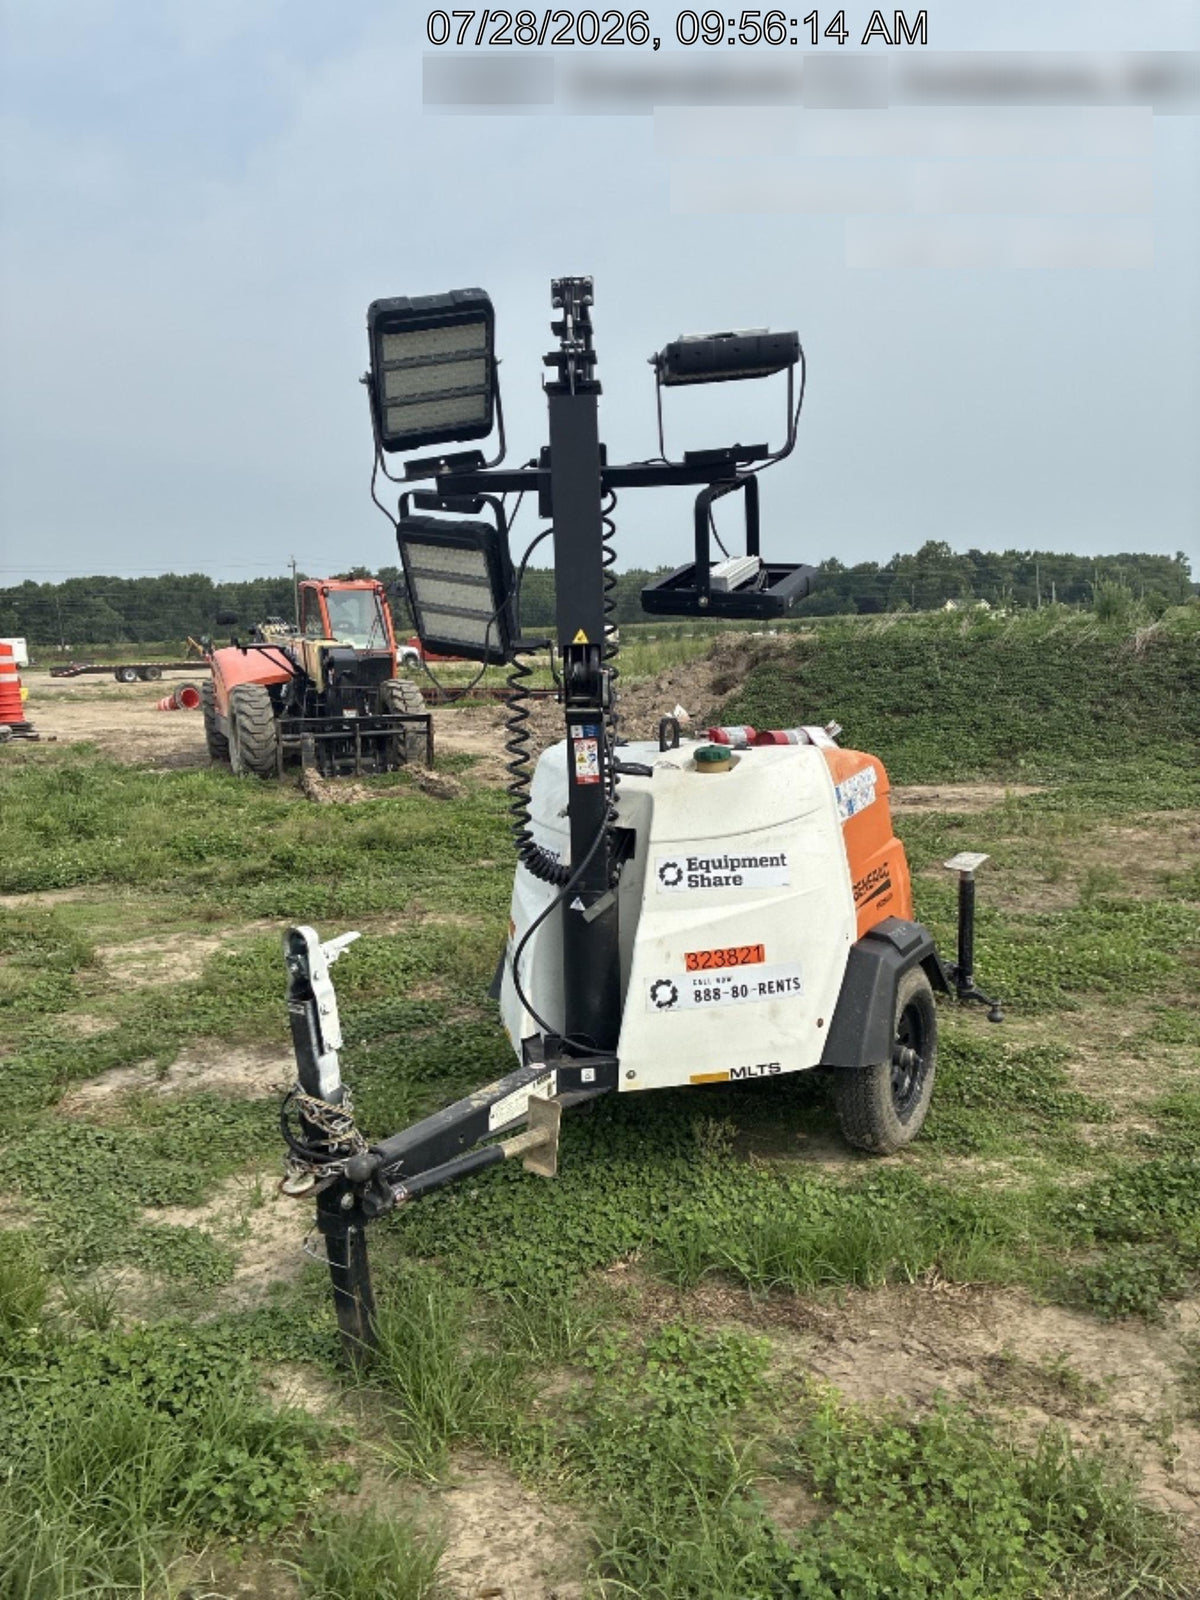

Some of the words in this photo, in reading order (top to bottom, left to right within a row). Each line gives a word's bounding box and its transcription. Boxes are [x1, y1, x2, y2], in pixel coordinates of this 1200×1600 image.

[686, 853, 787, 873] Equipment
[687, 874, 743, 888] Share
[687, 945, 763, 970] 323821
[729, 1062, 782, 1080] MLTS
